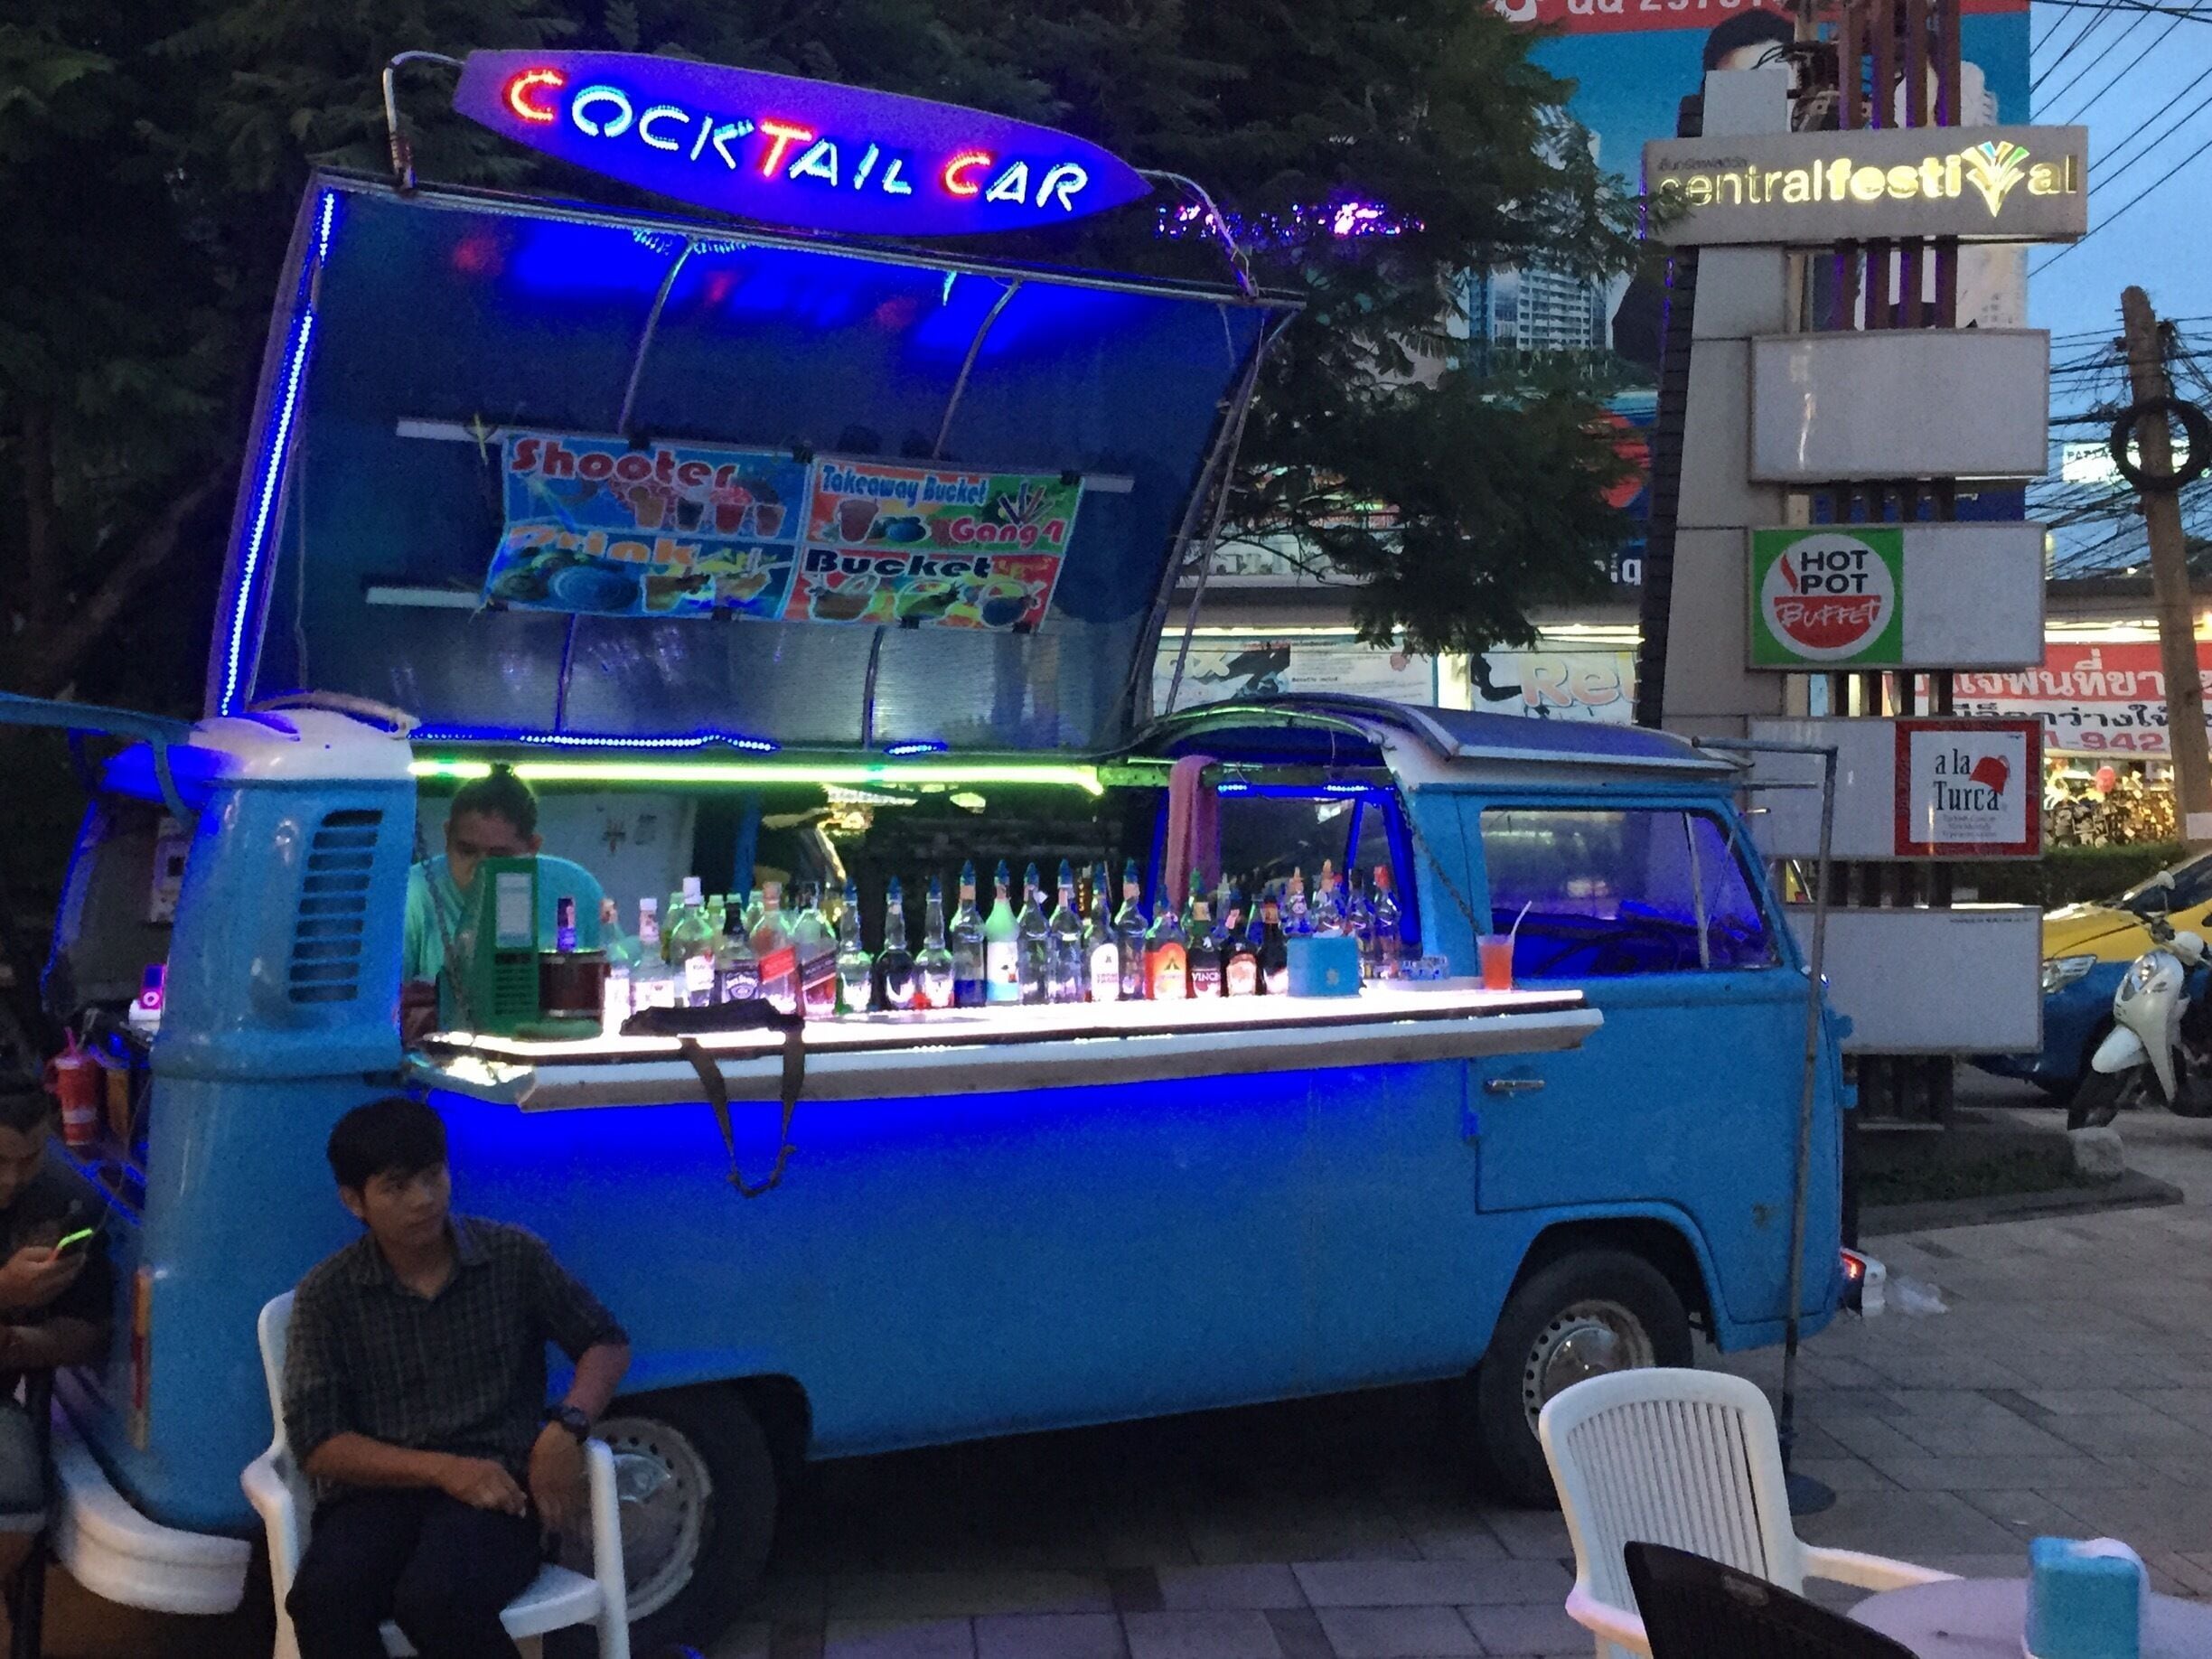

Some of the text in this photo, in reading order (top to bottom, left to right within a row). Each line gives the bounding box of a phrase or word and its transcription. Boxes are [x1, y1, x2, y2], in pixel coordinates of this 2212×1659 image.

[503, 68, 1089, 211] COCKTAIL CAR
[511, 437, 740, 490] Shooter
[820, 463, 989, 508] Takeaway Bucket
[950, 516, 1039, 549] Gang
[801, 548, 992, 579] Bucket
[1800, 549, 1870, 572] HOT
[1800, 573, 1870, 595] POT
[1935, 747, 1972, 775] a la
[1933, 780, 2000, 811] Turca
